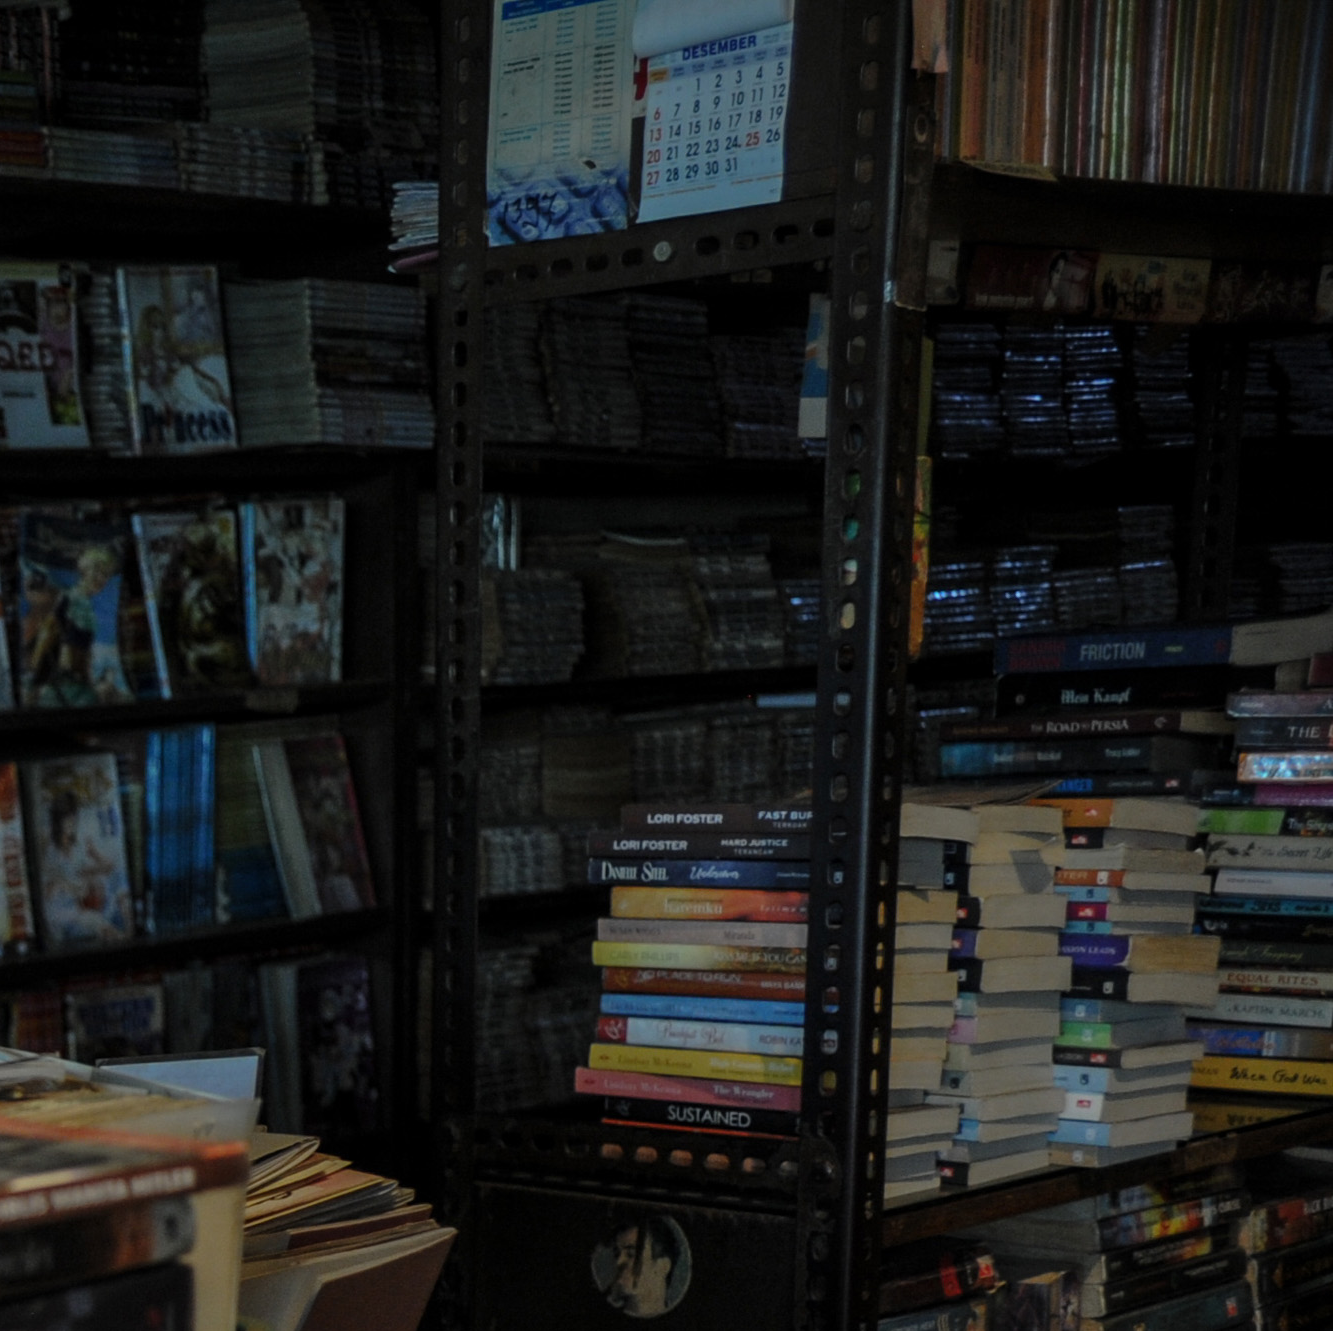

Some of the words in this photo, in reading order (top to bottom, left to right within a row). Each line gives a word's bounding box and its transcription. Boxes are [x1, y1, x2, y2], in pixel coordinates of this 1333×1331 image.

[682, 34, 758, 61] DESEMBER
[731, 91, 745, 107] 10
[751, 88, 764, 103] 11
[772, 83, 786, 98] 12
[649, 128, 662, 142] 13
[668, 124, 681, 139] 14
[688, 121, 701, 136] 15
[708, 117, 721, 131] 16
[728, 113, 741, 127] 17
[749, 109, 762, 124] 18
[769, 105, 783, 121] 19
[646, 149, 661, 164] 20
[666, 146, 679, 161] 21
[685, 142, 700, 157] 22
[705, 138, 719, 154] 23
[725, 135, 739, 149] 24
[745, 131, 760, 147] 25
[765, 128, 780, 143] 26
[646, 170, 660, 186] 27
[665, 167, 680, 182] 28
[685, 164, 699, 179] 29
[704, 160, 719, 176] 30
[724, 157, 738, 171] 31
[1079, 641, 1146, 661] FRICTION
[1045, 720, 1081, 733] ROAD
[1090, 718, 1130, 732] PERSIA
[1287, 725, 1322, 739] THE
[646, 812, 675, 824] LORI
[675, 812, 724, 825] FOSTER
[757, 810, 787, 821] FAST
[612, 839, 641, 851] LORI
[641, 839, 689, 851] FOSTER
[720, 838, 749, 848] HARD
[749, 838, 790, 848] JUSTICE
[600, 860, 638, 882] DANIELLE
[640, 861, 670, 884] STEEL
[1226, 972, 1272, 984] EQUAL
[1277, 973, 1320, 986] RITES
[1230, 1066, 1269, 1082] When
[667, 1104, 752, 1129] SUSTAINED
